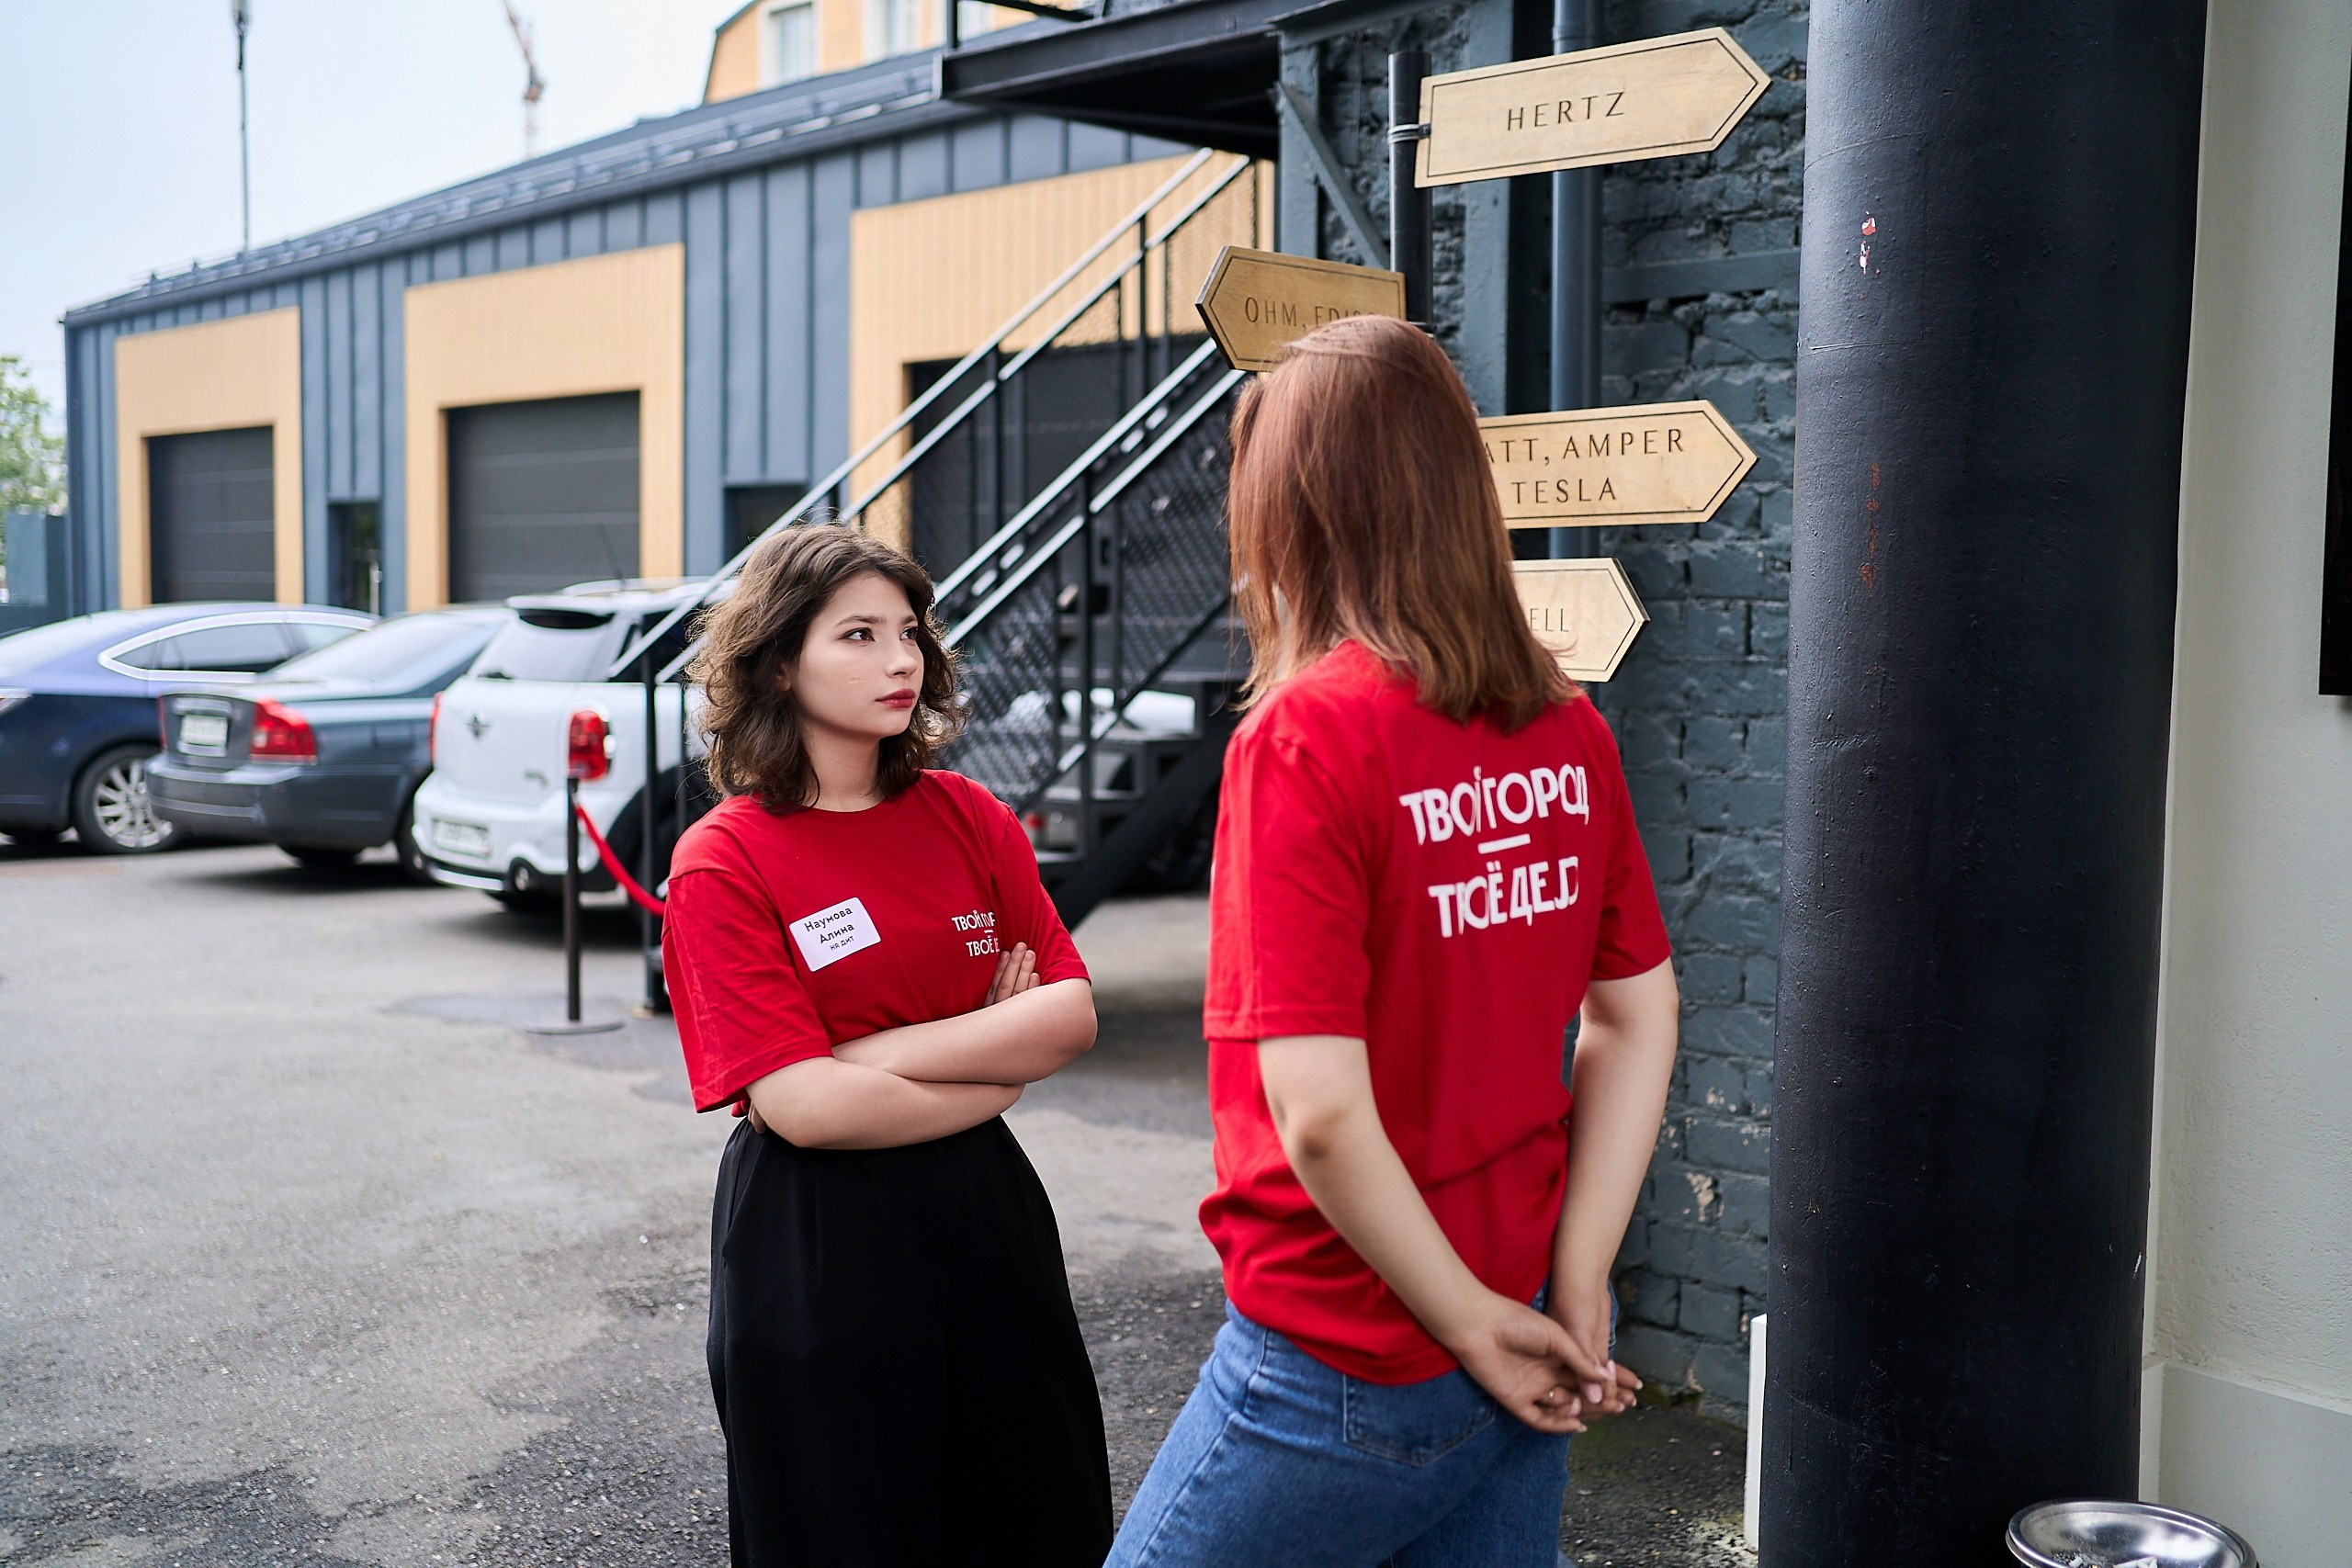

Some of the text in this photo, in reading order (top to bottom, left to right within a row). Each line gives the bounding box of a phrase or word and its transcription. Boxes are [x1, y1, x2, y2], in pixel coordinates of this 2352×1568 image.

[1508, 91, 1625, 131] HERTZ
[1245, 297, 1306, 332] OHM,
[1484, 428, 1684, 466] ATT, AMPER
[1511, 478, 1617, 504] TESLA
[1530, 608, 1569, 632] ELL
[804, 908, 853, 931] Наумова
[820, 924, 854, 943] Алина
